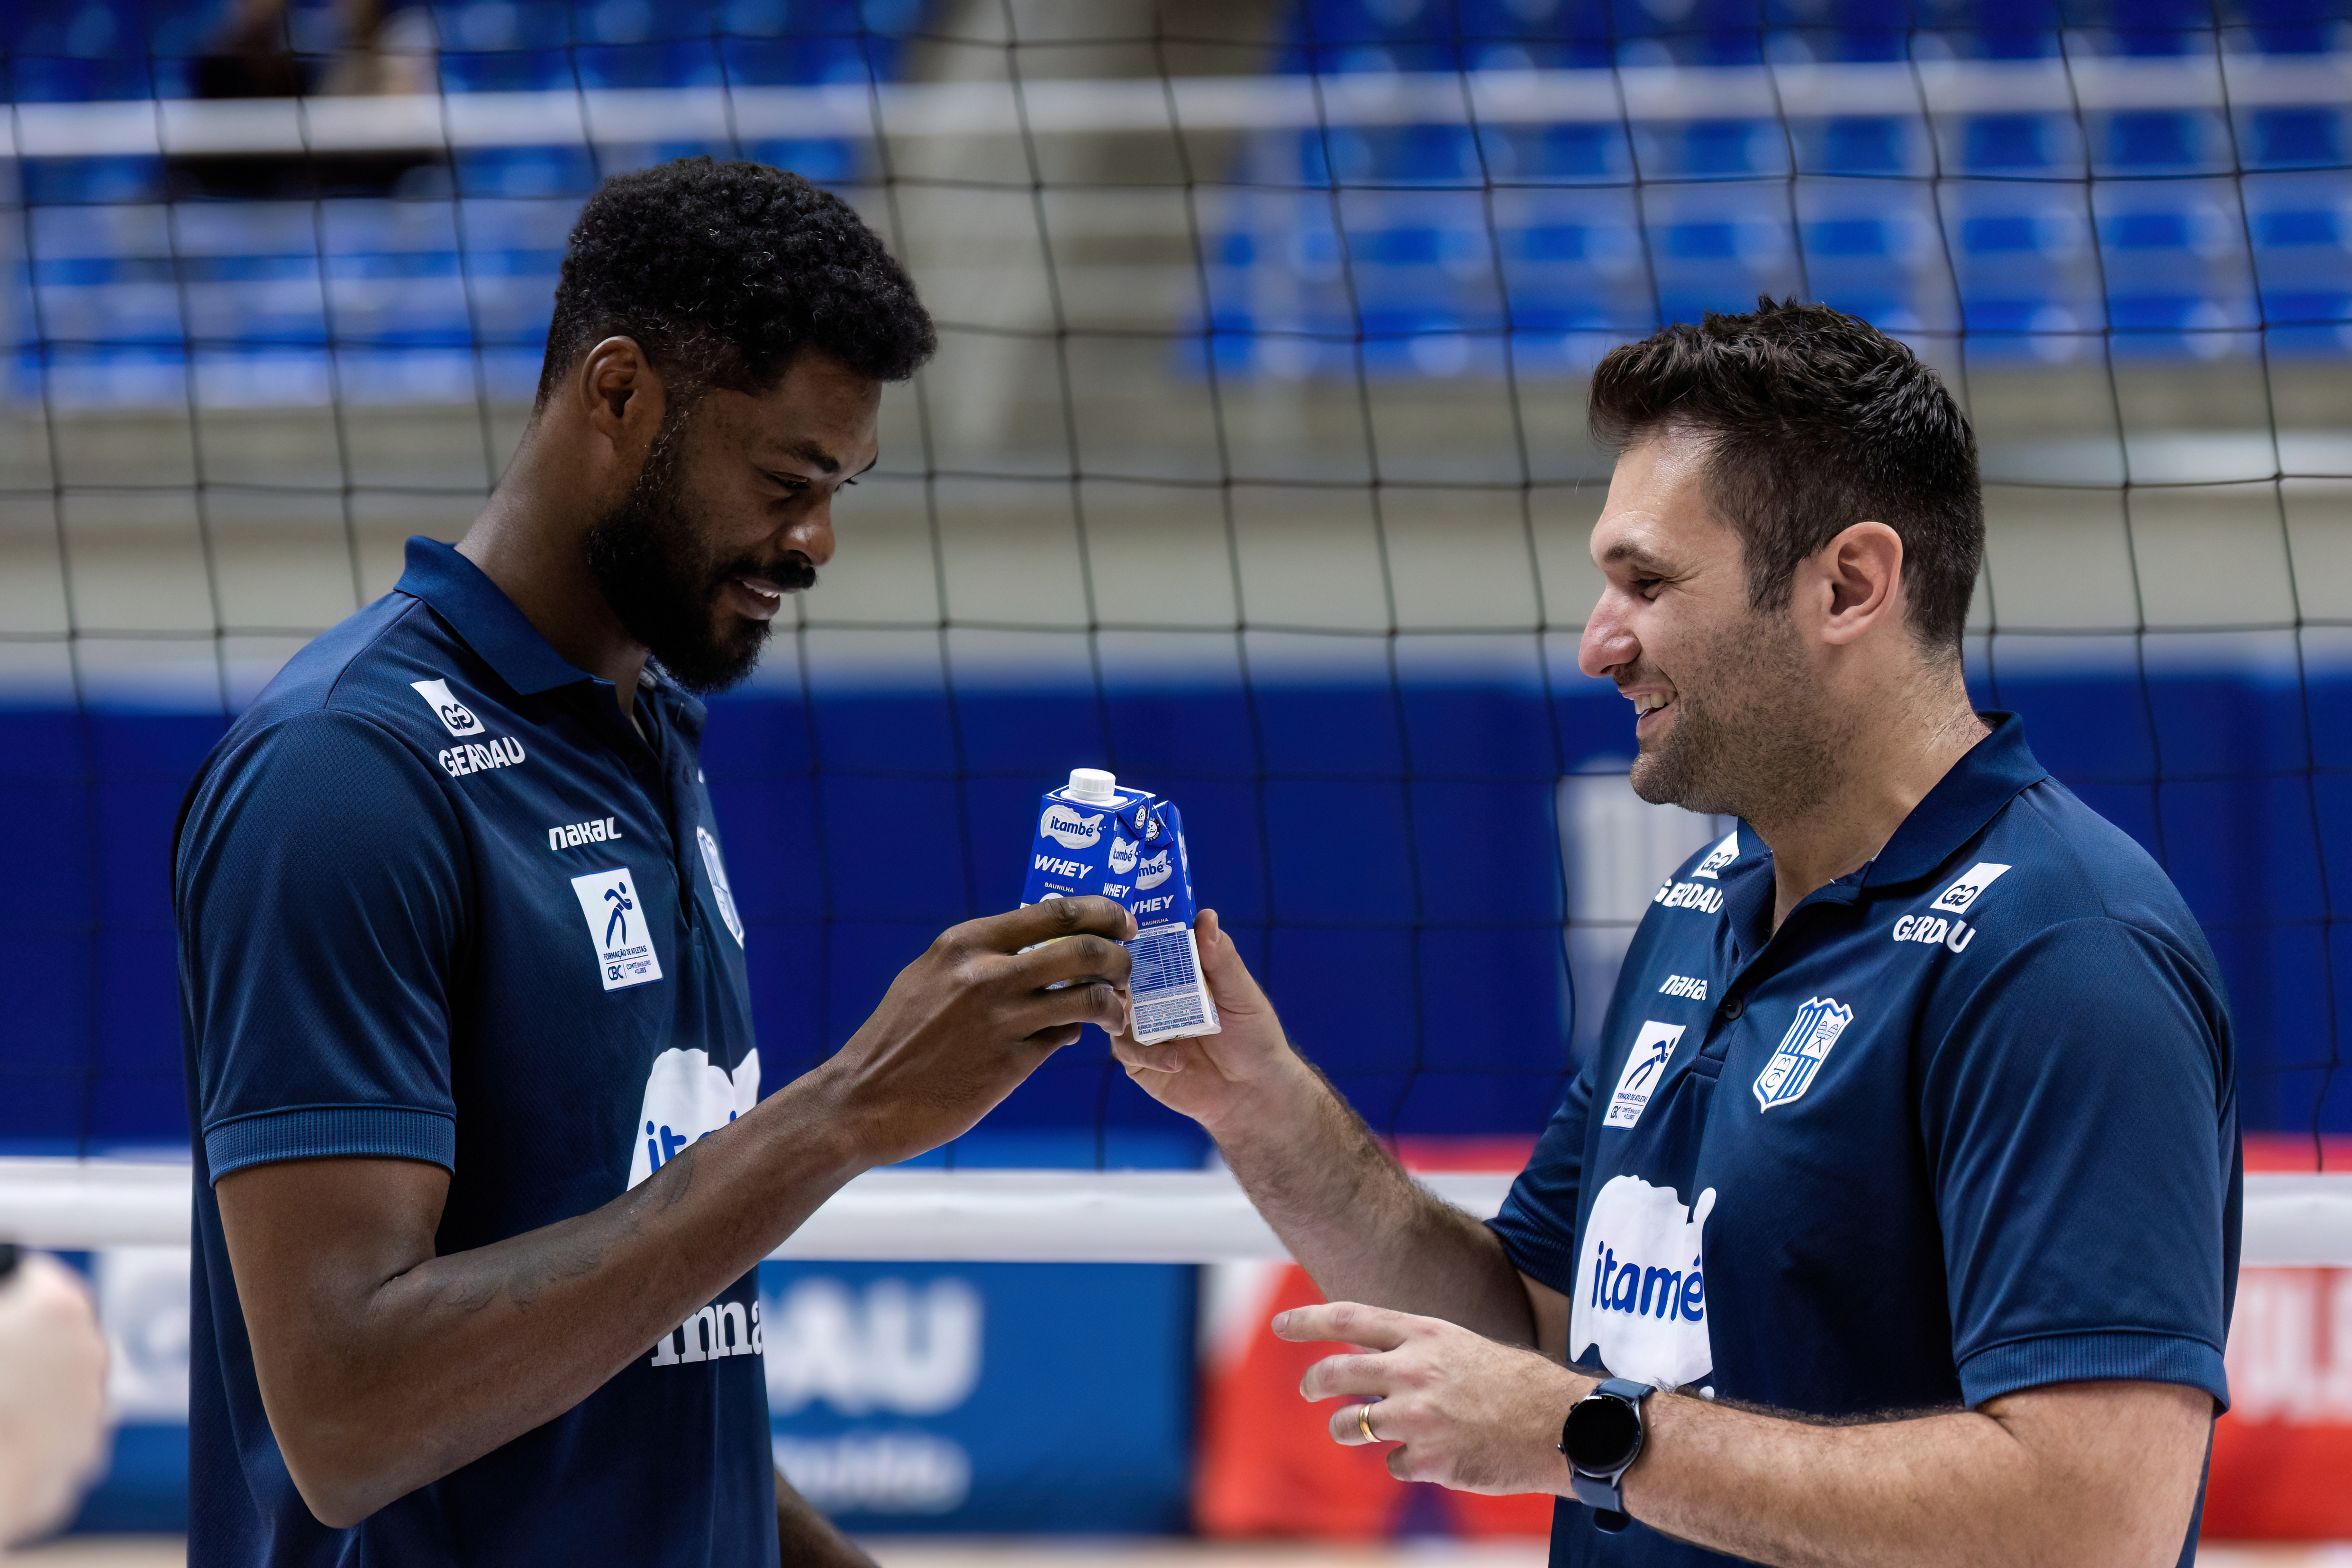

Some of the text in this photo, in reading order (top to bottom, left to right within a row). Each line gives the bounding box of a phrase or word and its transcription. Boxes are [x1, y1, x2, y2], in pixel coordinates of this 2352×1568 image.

[438, 736, 526, 778] GERDAU
[1050, 816, 1094, 837] itambé
[1035, 854, 1094, 879] WHEY
[1044, 882, 1074, 893] BAUNILHA
[1102, 882, 1131, 898] WHEY
[1142, 917, 1169, 926] BAUNILHA
[608, 964, 624, 981] CBC
